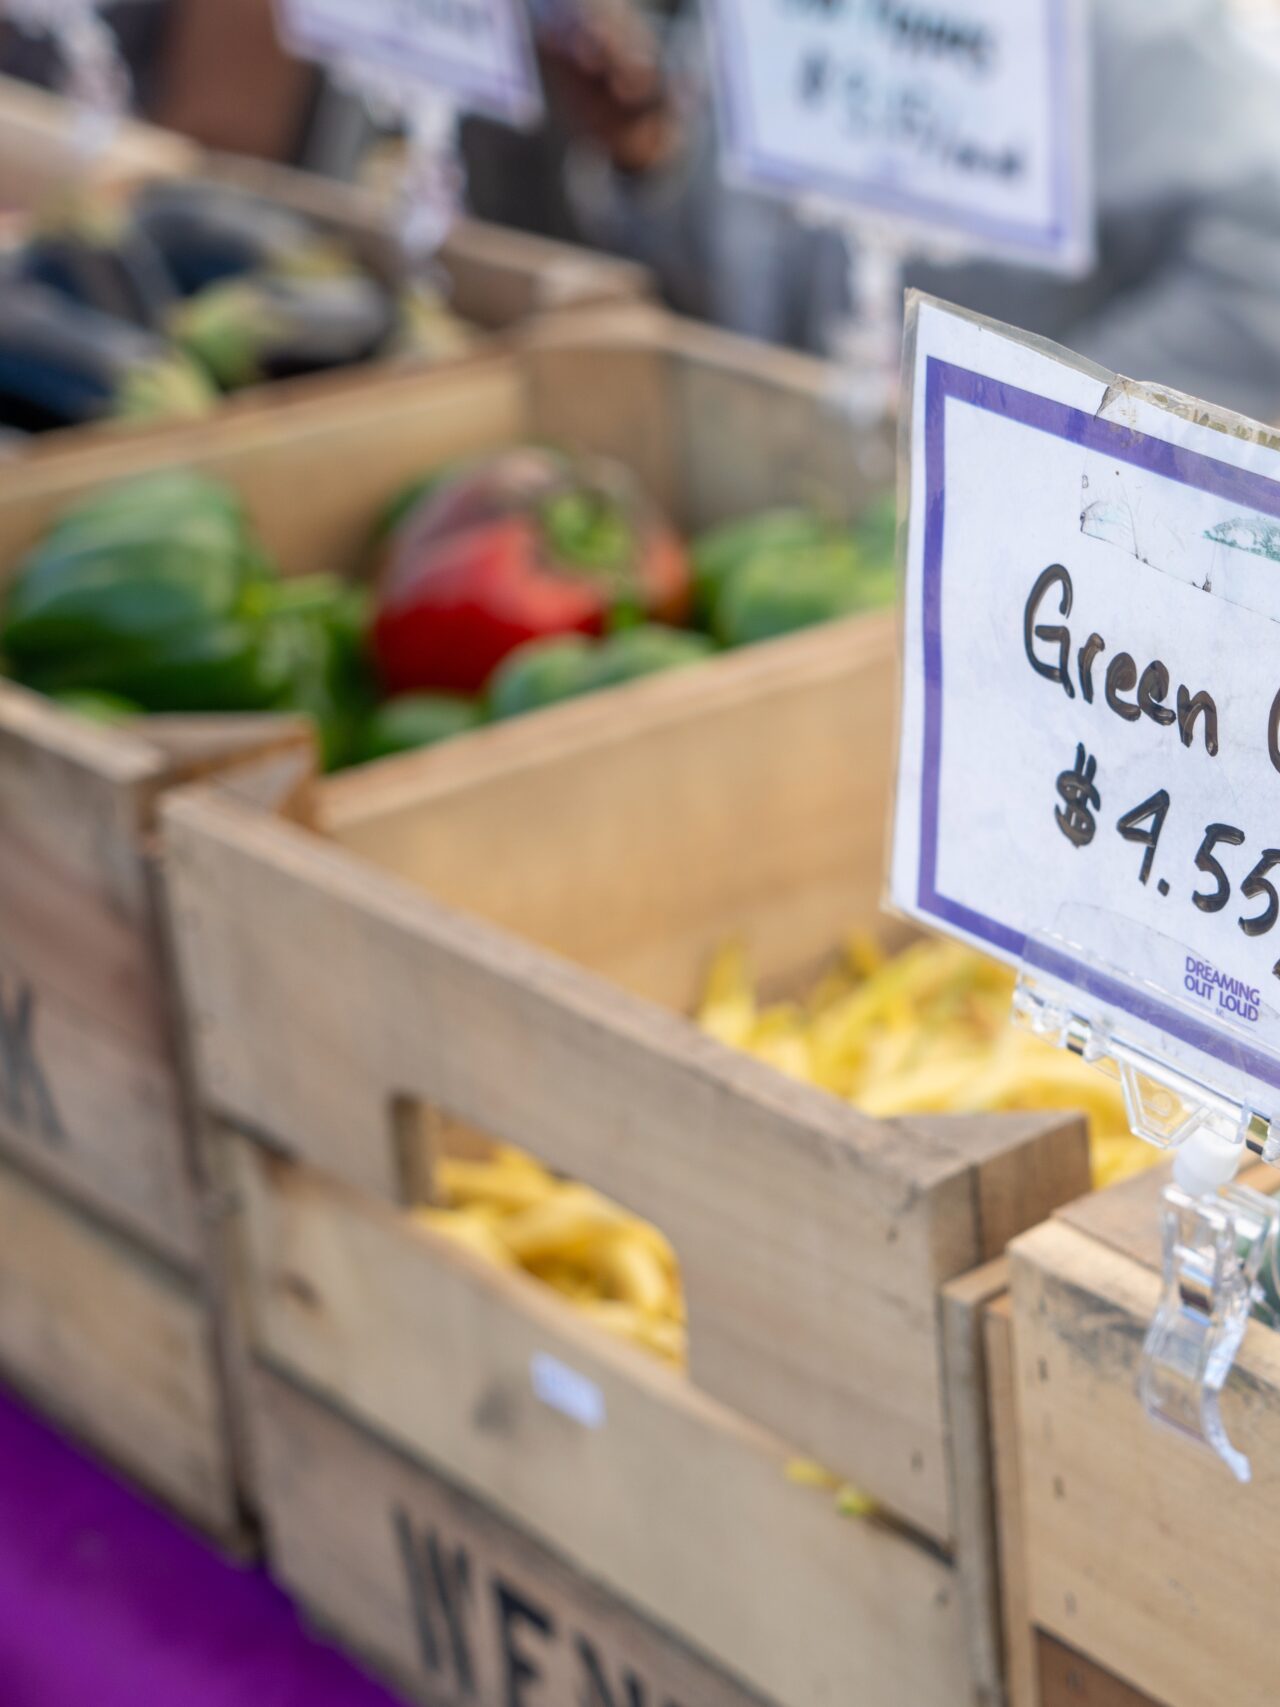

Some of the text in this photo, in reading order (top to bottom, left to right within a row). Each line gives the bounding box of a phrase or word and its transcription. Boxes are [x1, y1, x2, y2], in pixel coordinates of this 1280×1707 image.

[1024, 563, 1219, 757] Green
[1184, 975, 1259, 1021] OUT LOUD
[1186, 956, 1260, 1006] DREAMING
